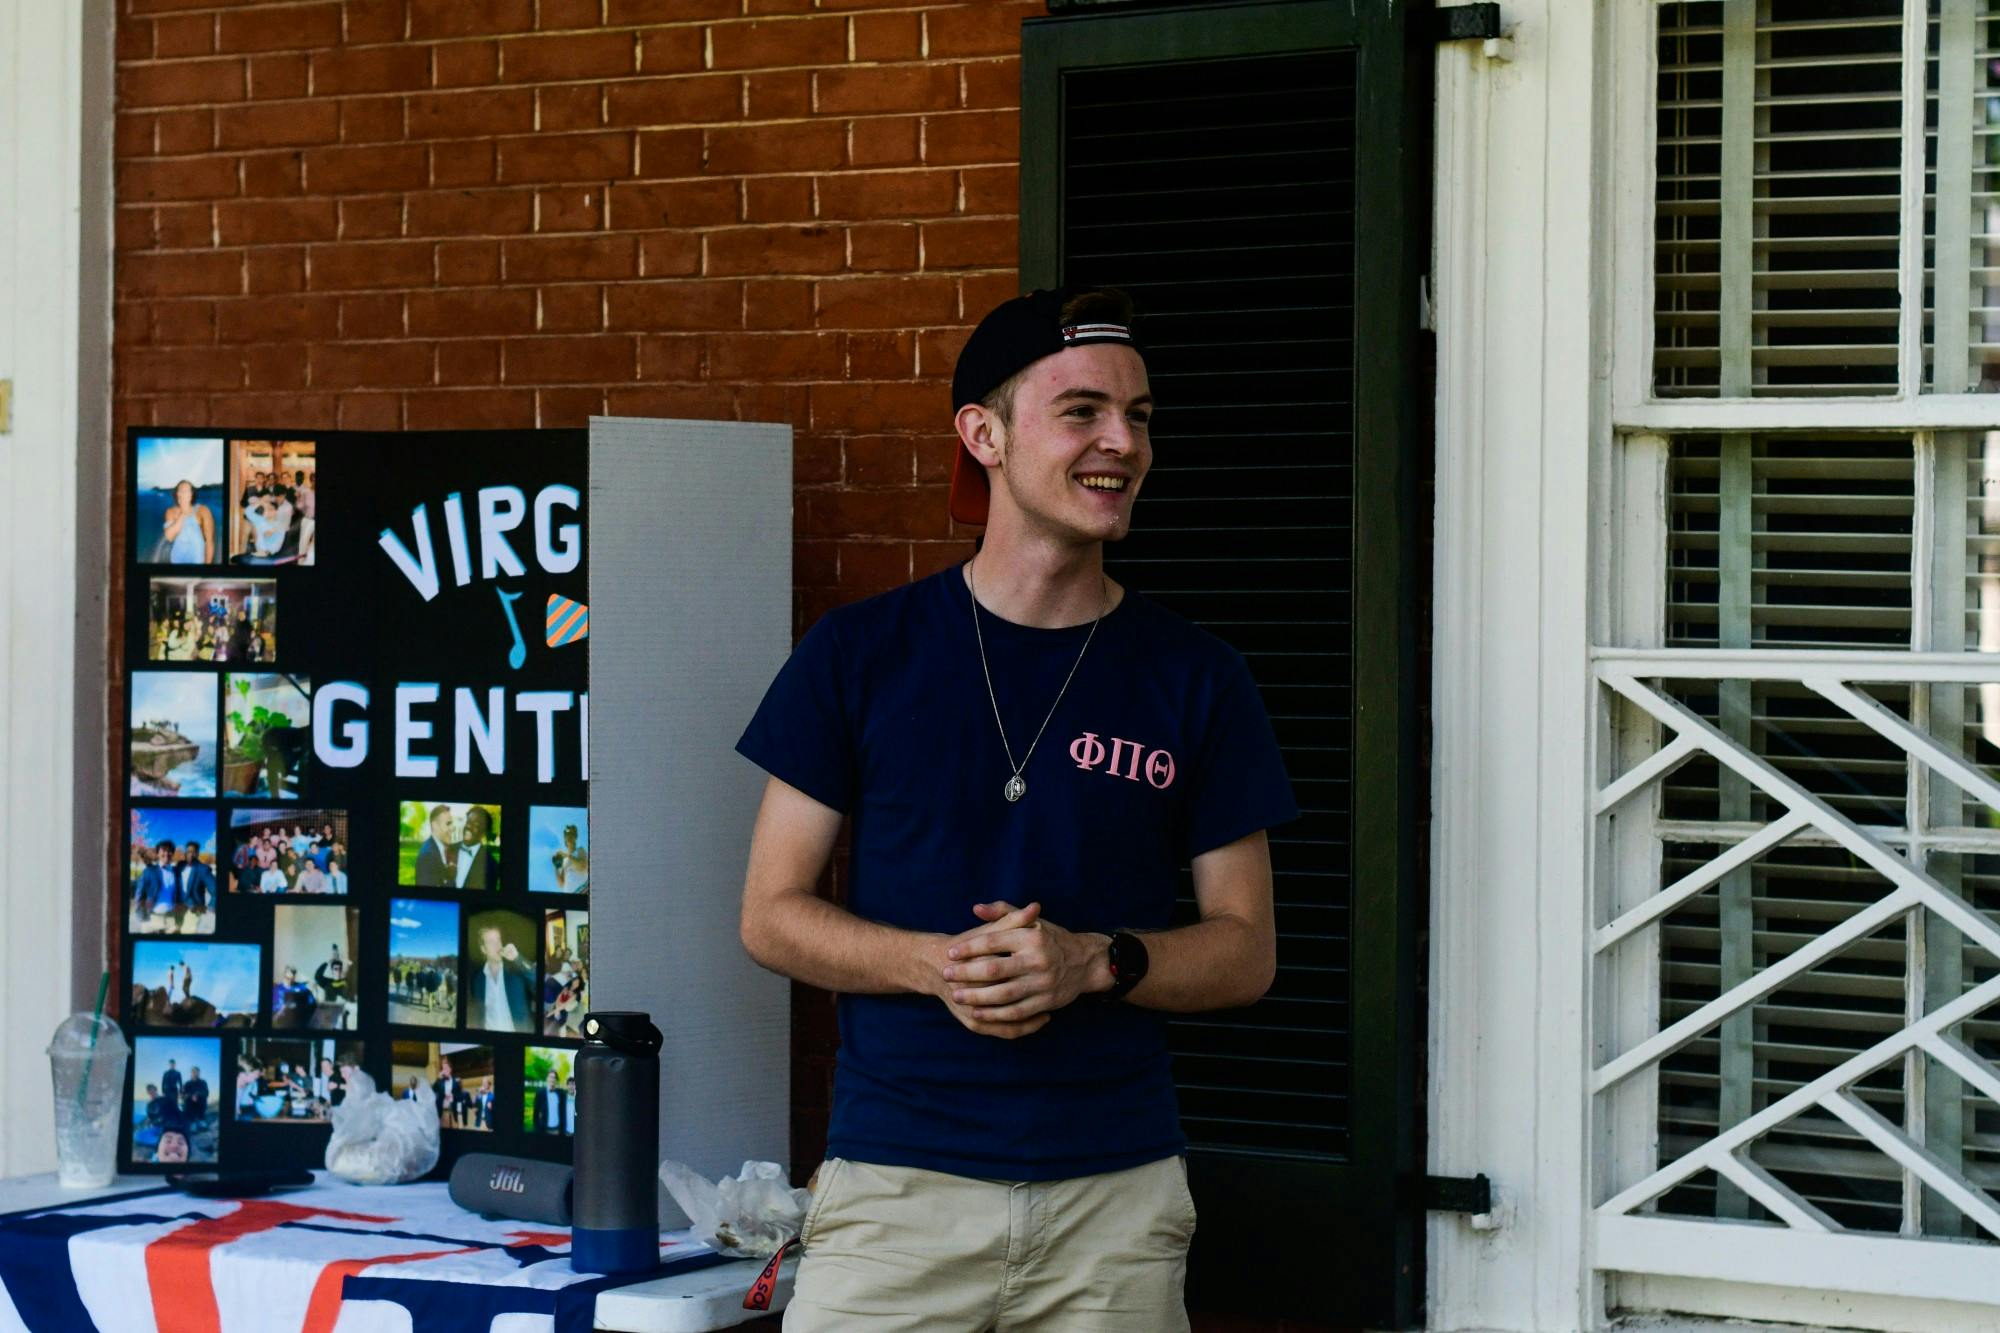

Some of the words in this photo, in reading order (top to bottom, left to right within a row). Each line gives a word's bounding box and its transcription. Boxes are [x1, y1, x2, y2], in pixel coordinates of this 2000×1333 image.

[378, 484, 582, 603] VIRG
[1069, 731, 1176, 789] ΦΠΘ
[490, 1168, 525, 1194] JBL
[753, 1281, 768, 1308] OS
